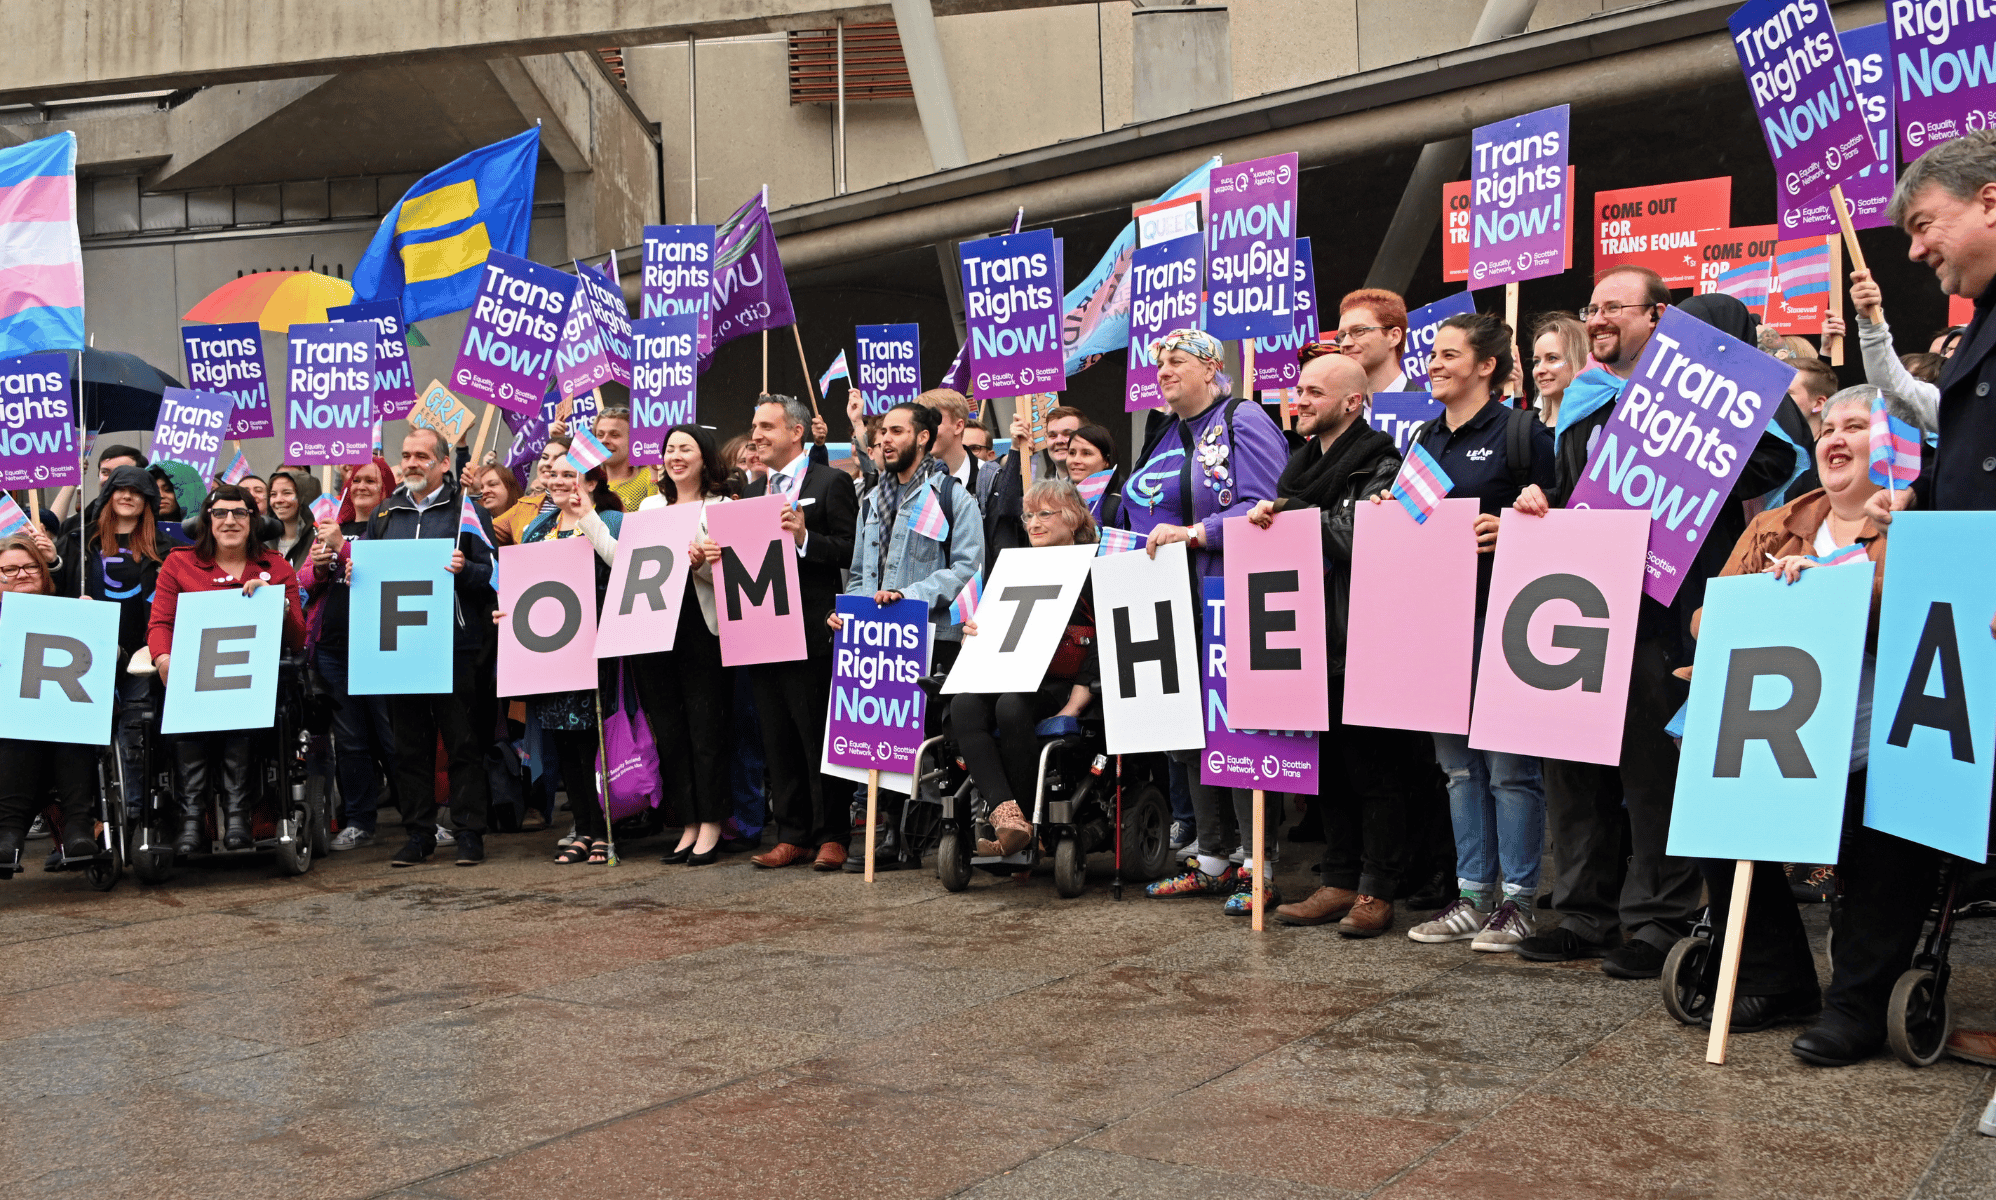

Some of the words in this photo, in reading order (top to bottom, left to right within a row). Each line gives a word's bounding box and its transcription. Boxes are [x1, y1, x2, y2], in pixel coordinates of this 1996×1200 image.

[1736, 0, 1818, 67] Trans
[1751, 31, 1834, 108] Rights
[1898, 41, 1996, 102] Now
[1764, 64, 1854, 159] Now!
[1927, 119, 1957, 132] Equality
[1840, 134, 1863, 152] Scottish
[1928, 128, 1960, 141] Network
[1475, 131, 1560, 173] Trans
[1842, 147, 1859, 161] Trans
[1799, 161, 1820, 180] Equality
[1802, 168, 1825, 187] Network
[1475, 164, 1561, 209] Rights
[1857, 196, 1887, 208] Scottish
[1449, 210, 1470, 228] FO
[1474, 193, 1562, 249] Now!
[1601, 202, 1643, 221] COME
[1648, 197, 1677, 214] OUT
[1802, 205, 1830, 219] Equality
[1803, 213, 1831, 224] Network
[1858, 205, 1877, 215] Trans
[1143, 210, 1196, 241] QUEER
[1211, 200, 1291, 251] Now!
[1601, 220, 1631, 239] FOR
[644, 238, 709, 263] Trans
[1534, 249, 1558, 260] Scottish
[1601, 235, 1647, 256] TRANS
[1703, 242, 1743, 261] COME
[1748, 239, 1778, 257] OUT
[963, 253, 1048, 287] Trans
[1133, 257, 1197, 295] Trans
[1211, 240, 1290, 284] Rights
[1489, 259, 1512, 269] Equality
[1489, 266, 1512, 275] Network
[1534, 259, 1549, 267] Trans
[486, 264, 565, 314] Trans
[580, 272, 627, 316] Trans
[644, 263, 710, 294] Rights
[968, 283, 1053, 324] Rights
[1132, 289, 1197, 333] Rights
[1212, 283, 1290, 317] Trans
[1786, 305, 1817, 314] Stonewall
[474, 295, 559, 343] Rights
[590, 298, 632, 337] Rights
[185, 338, 257, 360] Trans
[290, 338, 368, 364] Trans
[632, 333, 692, 361] Trans
[857, 338, 914, 360] Trans
[971, 313, 1058, 360] Now!
[463, 326, 553, 381] Now!
[0, 372, 63, 396] rans
[191, 360, 262, 388] Rights
[290, 366, 370, 400] Rights
[633, 361, 693, 397] Rights
[860, 362, 916, 391] Rights
[992, 373, 1014, 382] Equality
[992, 379, 1016, 387] Network
[1035, 367, 1059, 376] Scottish
[1036, 374, 1052, 382] Trans
[1645, 332, 1761, 429] Trans
[0, 397, 69, 429] ights
[164, 399, 224, 429] Trans
[290, 396, 370, 430] Now!
[425, 387, 465, 435] GRA
[632, 390, 693, 428] Now!
[155, 424, 220, 454] Rights
[346, 442, 367, 450] Scottish
[1618, 383, 1737, 478] Rights
[304, 443, 326, 452] Equality
[4, 469, 28, 479] Equality
[50, 465, 75, 473] Scottish
[1589, 432, 1720, 542] Now!
[1644, 563, 1661, 579] rans
[1646, 550, 1677, 576] Scottish
[618, 545, 675, 616] R
[719, 539, 790, 622] M
[379, 580, 434, 652] F
[512, 580, 582, 653] O
[837, 613, 919, 650] Trans
[999, 584, 1063, 653] T
[1247, 569, 1302, 671] E
[1501, 572, 1610, 694] G
[195, 624, 258, 692] E
[1112, 599, 1180, 699] H
[19, 631, 94, 704] R
[837, 647, 920, 690] Rights
[1886, 600, 1976, 765] A
[834, 685, 920, 730] Now!
[1712, 645, 1823, 779] R
[1226, 755, 1254, 767] Equality
[1226, 763, 1256, 775] Network
[1281, 760, 1311, 771] Scottish
[1281, 768, 1301, 778] Trans
